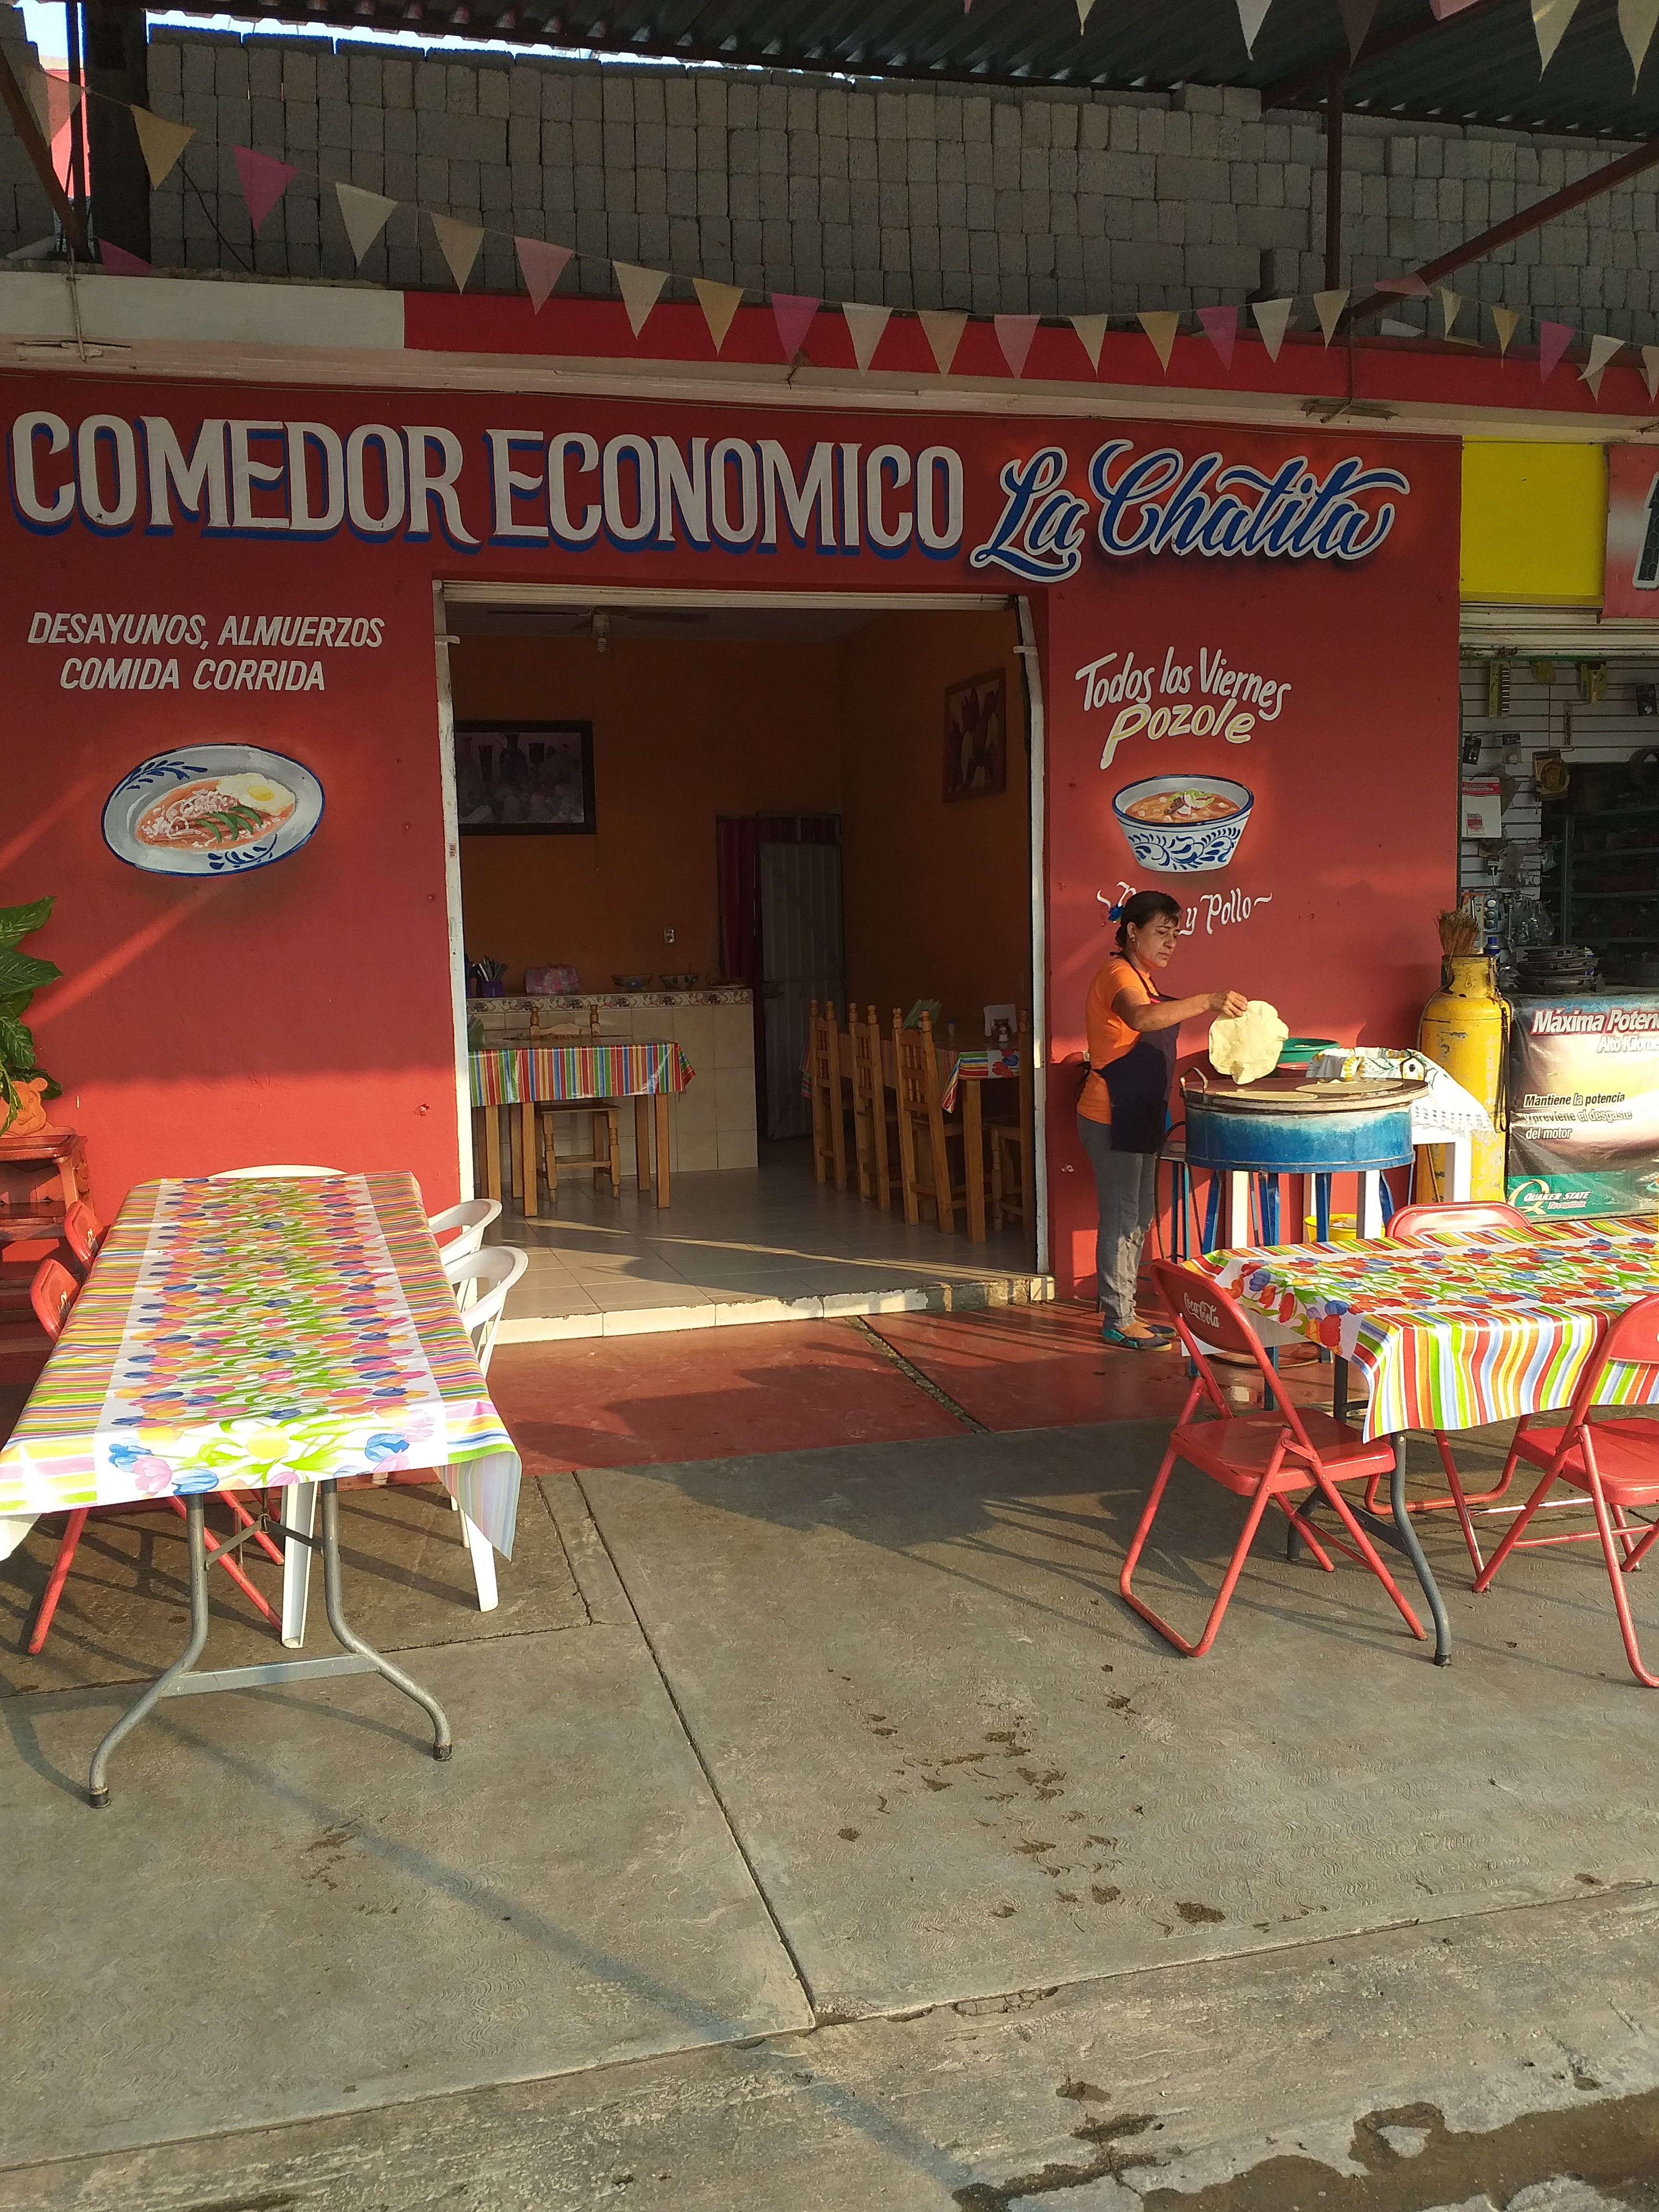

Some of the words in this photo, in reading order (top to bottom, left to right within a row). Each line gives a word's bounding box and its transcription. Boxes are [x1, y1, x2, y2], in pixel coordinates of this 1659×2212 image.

[10, 411, 482, 548] COMEDOR
[484, 429, 964, 554] ECONOMICO
[970, 446, 1089, 582] La
[1089, 439, 1410, 560] Chatita
[27, 612, 209, 650] DESAYUNOS,
[217, 615, 385, 648] ALMUERZOS
[60, 657, 179, 690] COMIDA
[192, 659, 325, 691] CORRIDA
[1075, 652, 1155, 711] Todos
[1159, 646, 1193, 694] los
[1200, 647, 1292, 721] Viernes
[1100, 697, 1255, 769] Pozole
[1178, 906, 1197, 935] y
[1200, 887, 1251, 935] Pollo
[1531, 1008, 1605, 1034] Máxima
[1597, 1035, 1622, 1053] Alto
[1524, 1094, 1571, 1106] Mantiene
[1573, 1093, 1584, 1106] la
[1585, 1092, 1625, 1106] potencia
[1533, 1111, 1576, 1124] previene
[1577, 1109, 1588, 1122] el
[1589, 1109, 1633, 1123] desgaste
[1526, 1128, 1541, 1140] del
[1542, 1128, 1573, 1140] motor
[1523, 1192, 1563, 1202] QUAKER
[1563, 1191, 1591, 1200] STATE
